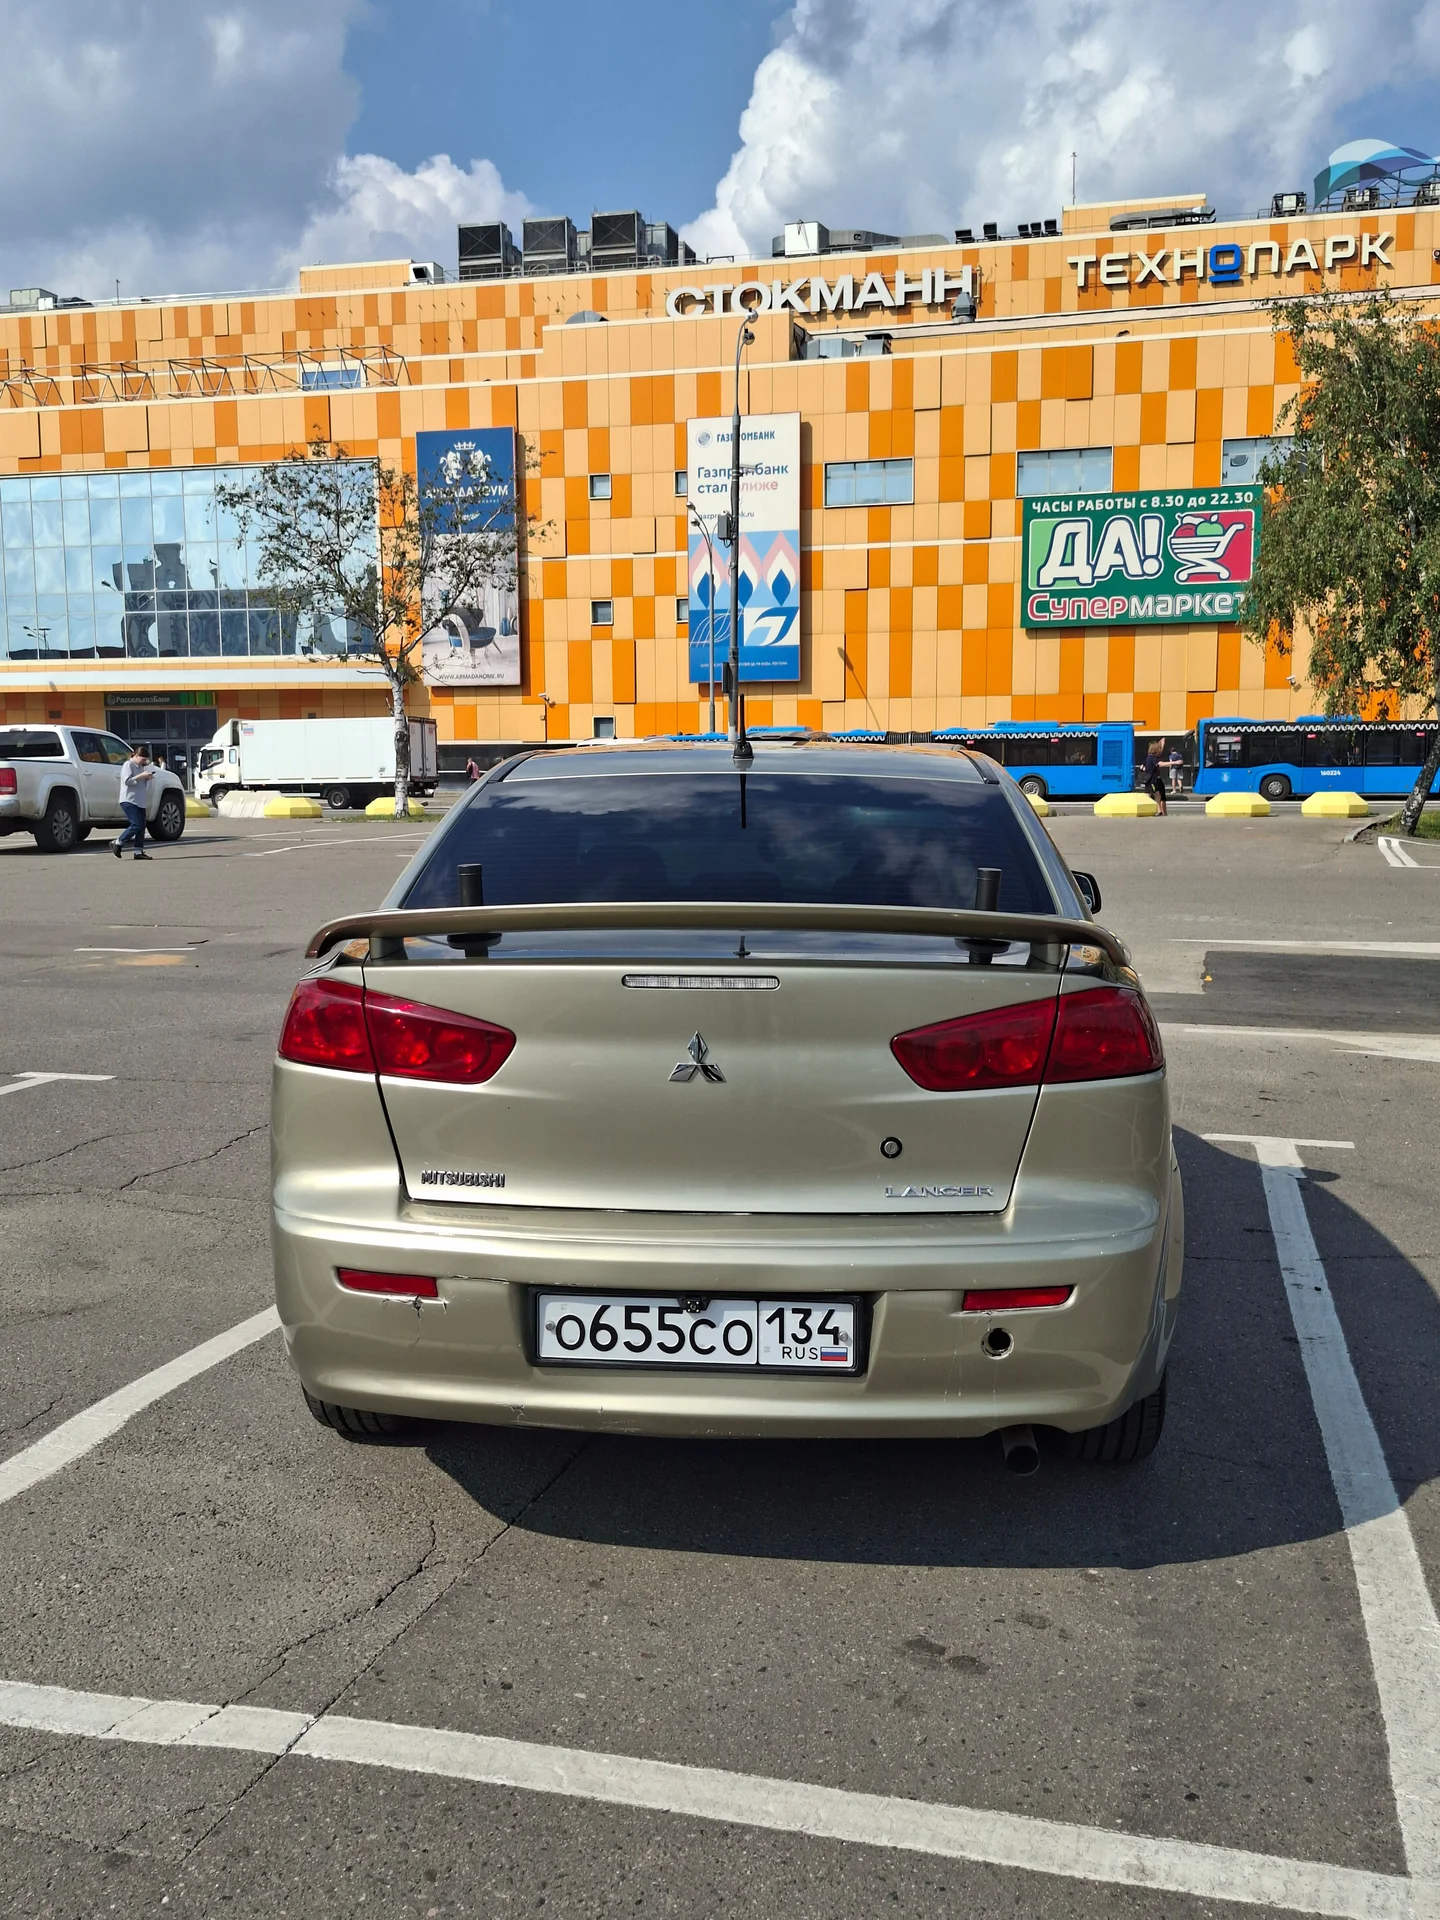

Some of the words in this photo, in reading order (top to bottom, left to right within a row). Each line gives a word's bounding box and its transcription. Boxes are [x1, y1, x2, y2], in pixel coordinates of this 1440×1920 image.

[1067, 231, 1392, 286] ТЕХНОПАРК
[665, 265, 973, 318] СТОКМАНН
[716, 431, 776, 443] ГАЗОМБАНК
[697, 462, 789, 479] Газпрмбанк
[697, 483, 728, 494] стал
[735, 480, 779, 492] лиже
[1032, 500, 1073, 513] ЧАСЫ
[1077, 497, 1136, 511] РАБОТЫ
[1151, 495, 1184, 508] 8.30
[1187, 496, 1206, 509] до
[1210, 491, 1254, 506] 22.30
[699, 511, 755, 520] gazprk.ru
[1036, 513, 1165, 588] ДА!
[421, 1170, 506, 1188] MITSUBISHI
[885, 1185, 994, 1198] LANCER
[765, 1307, 840, 1346] 134
[782, 1346, 818, 1360] RUS
